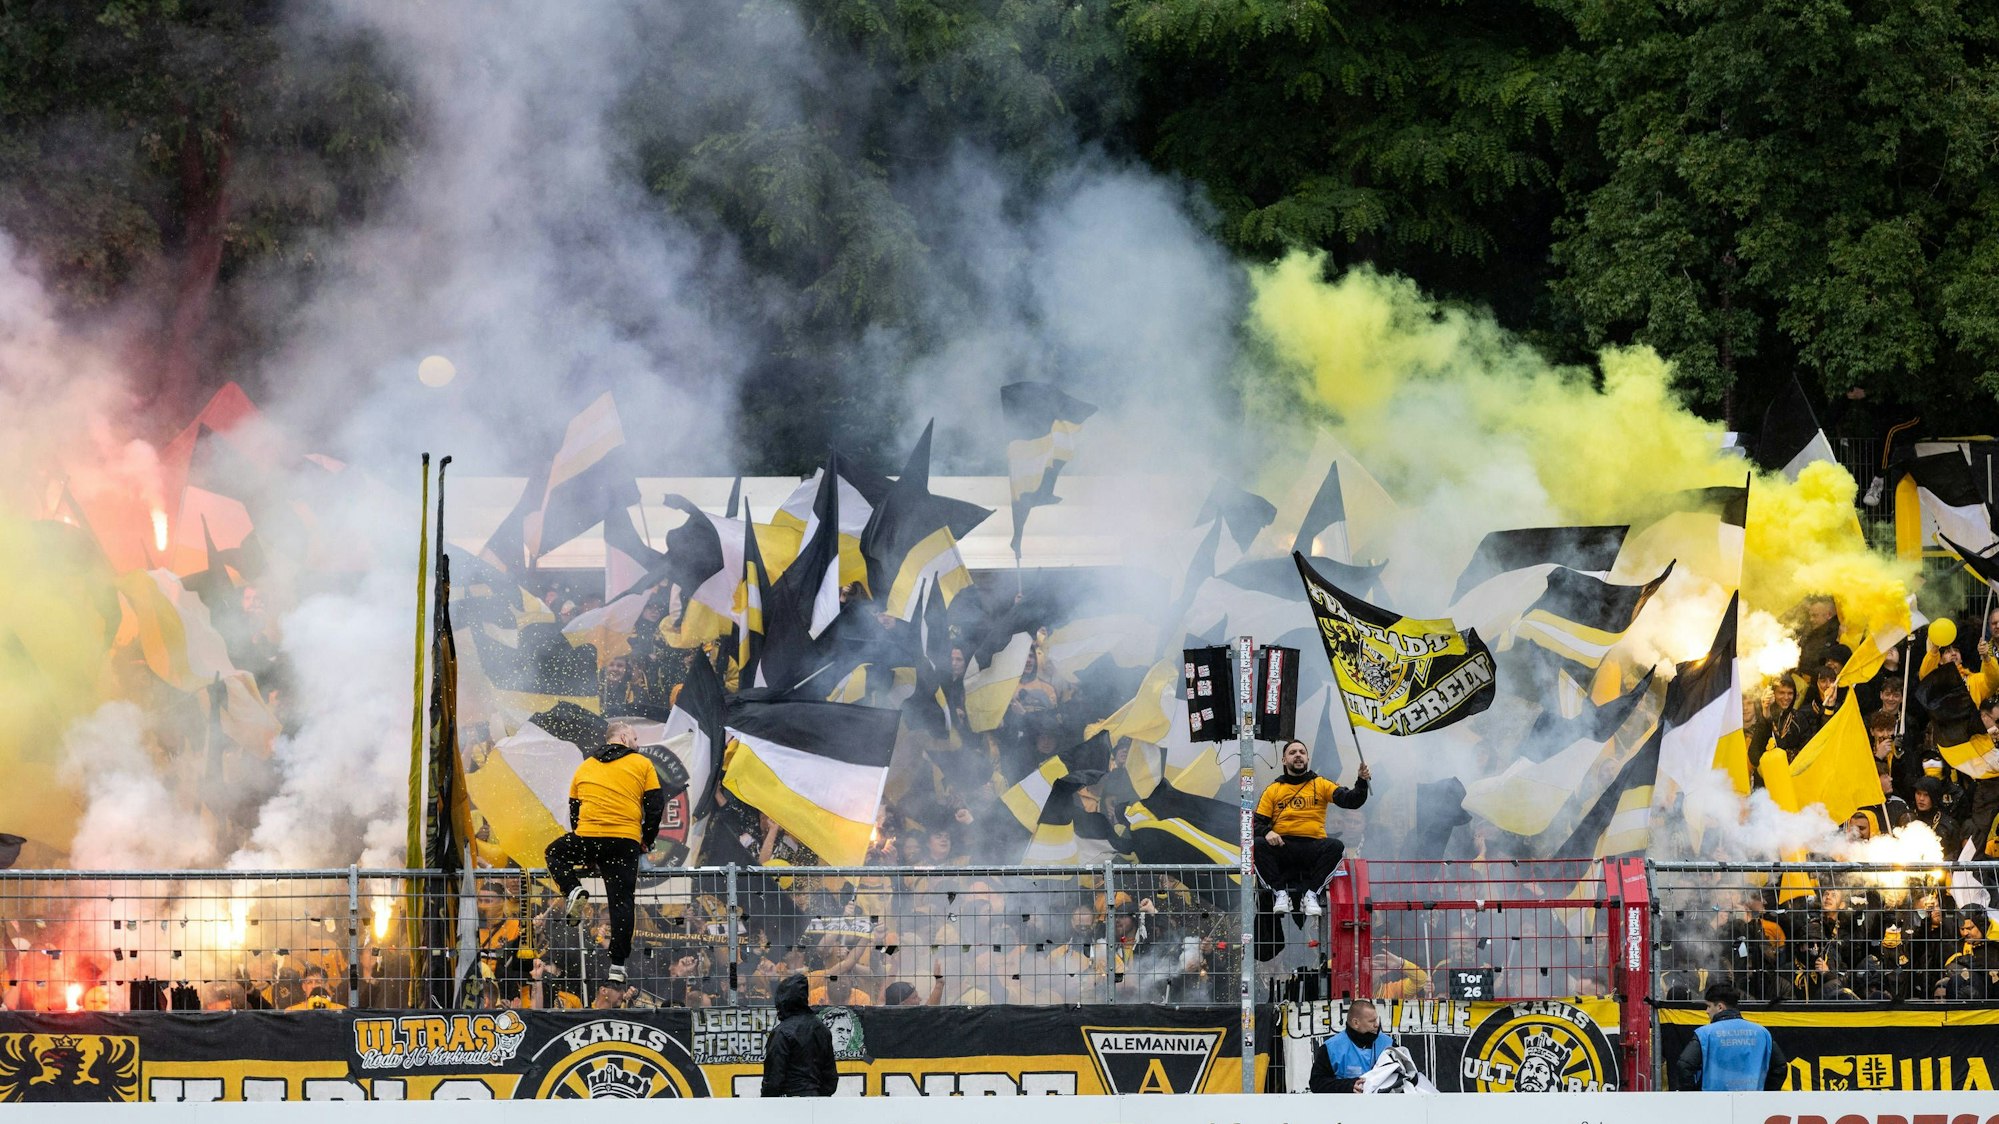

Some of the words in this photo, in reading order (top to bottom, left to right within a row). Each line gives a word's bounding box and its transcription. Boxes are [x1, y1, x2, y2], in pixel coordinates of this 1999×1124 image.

[1391, 655, 1493, 735] VEREIN
[1459, 973, 1482, 984] Tor
[1464, 986, 1482, 998] 26
[1288, 999, 1392, 1038] GEGN
[1399, 1000, 1472, 1034] ALLE
[1510, 1000, 1590, 1029] KARLS
[355, 1019, 496, 1053] ULTRAS
[564, 1019, 668, 1053] KARLS
[1100, 1037, 1209, 1052] ALEMANNIA
[1720, 1038, 1756, 1047] SERVICE
[363, 1048, 400, 1069] Roda
[431, 1045, 492, 1066] Kerkrade
[694, 1053, 738, 1065] Werner
[741, 1051, 766, 1064] Fuc
[1138, 1058, 1174, 1094] A
